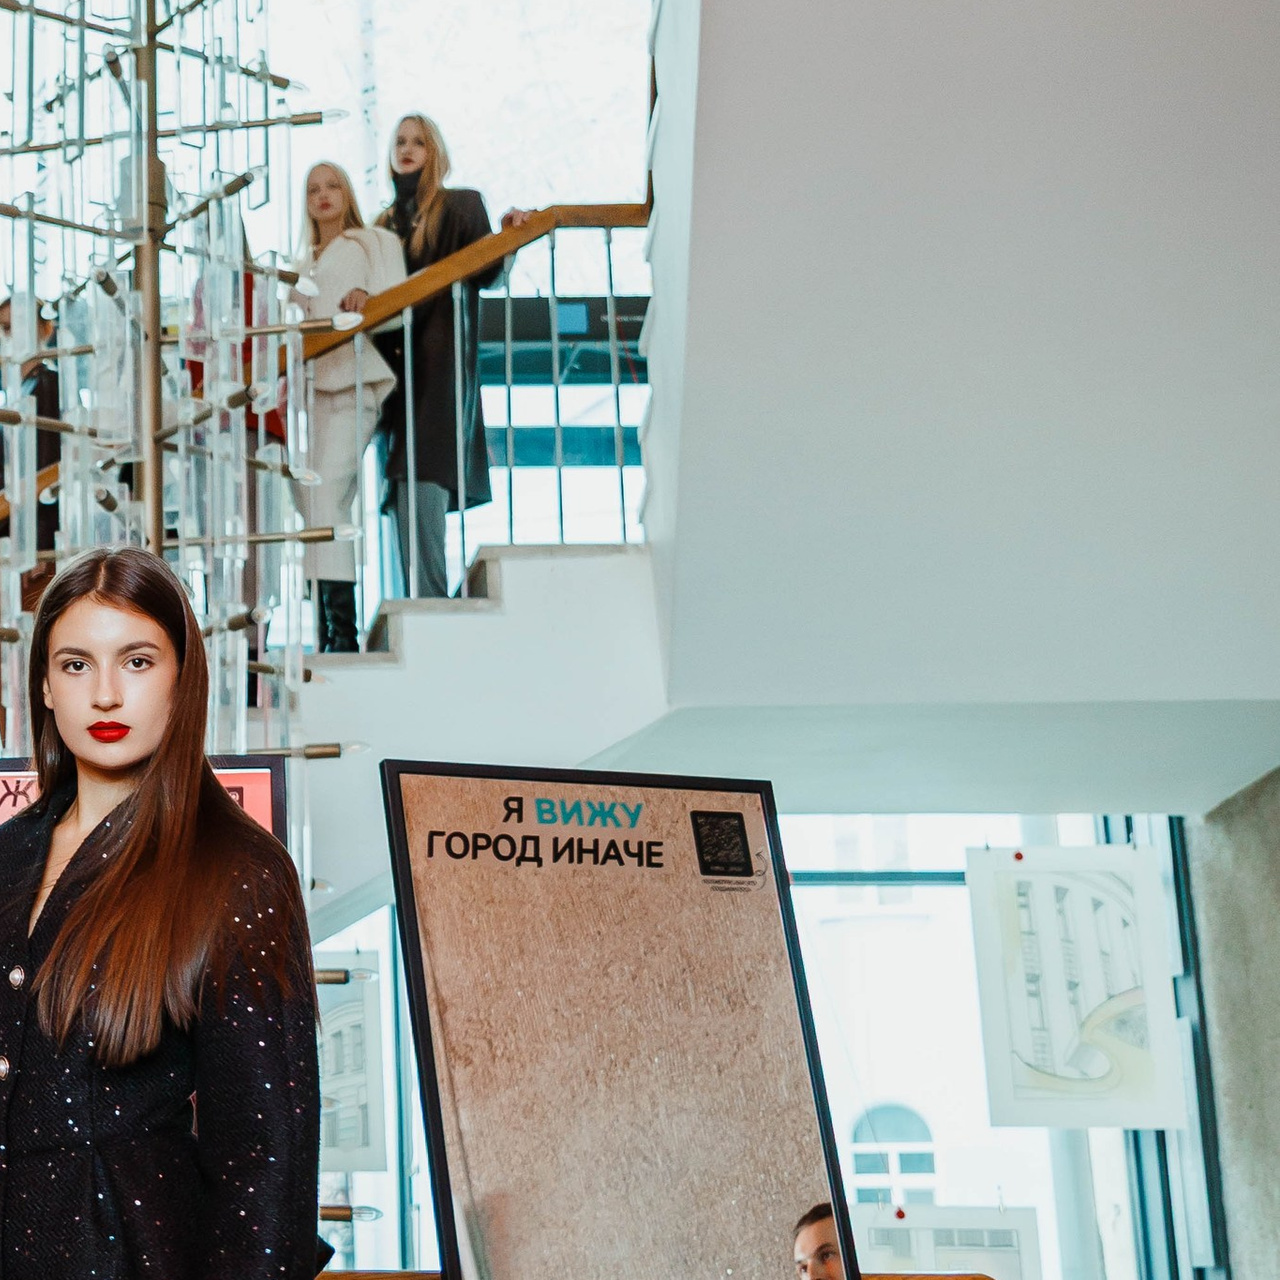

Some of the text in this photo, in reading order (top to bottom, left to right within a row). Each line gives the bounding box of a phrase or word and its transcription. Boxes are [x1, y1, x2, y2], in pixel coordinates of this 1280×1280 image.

[503, 797, 644, 828] Я ВИЖУ
[427, 831, 665, 868] ГОРОД ИНАЧЕ
